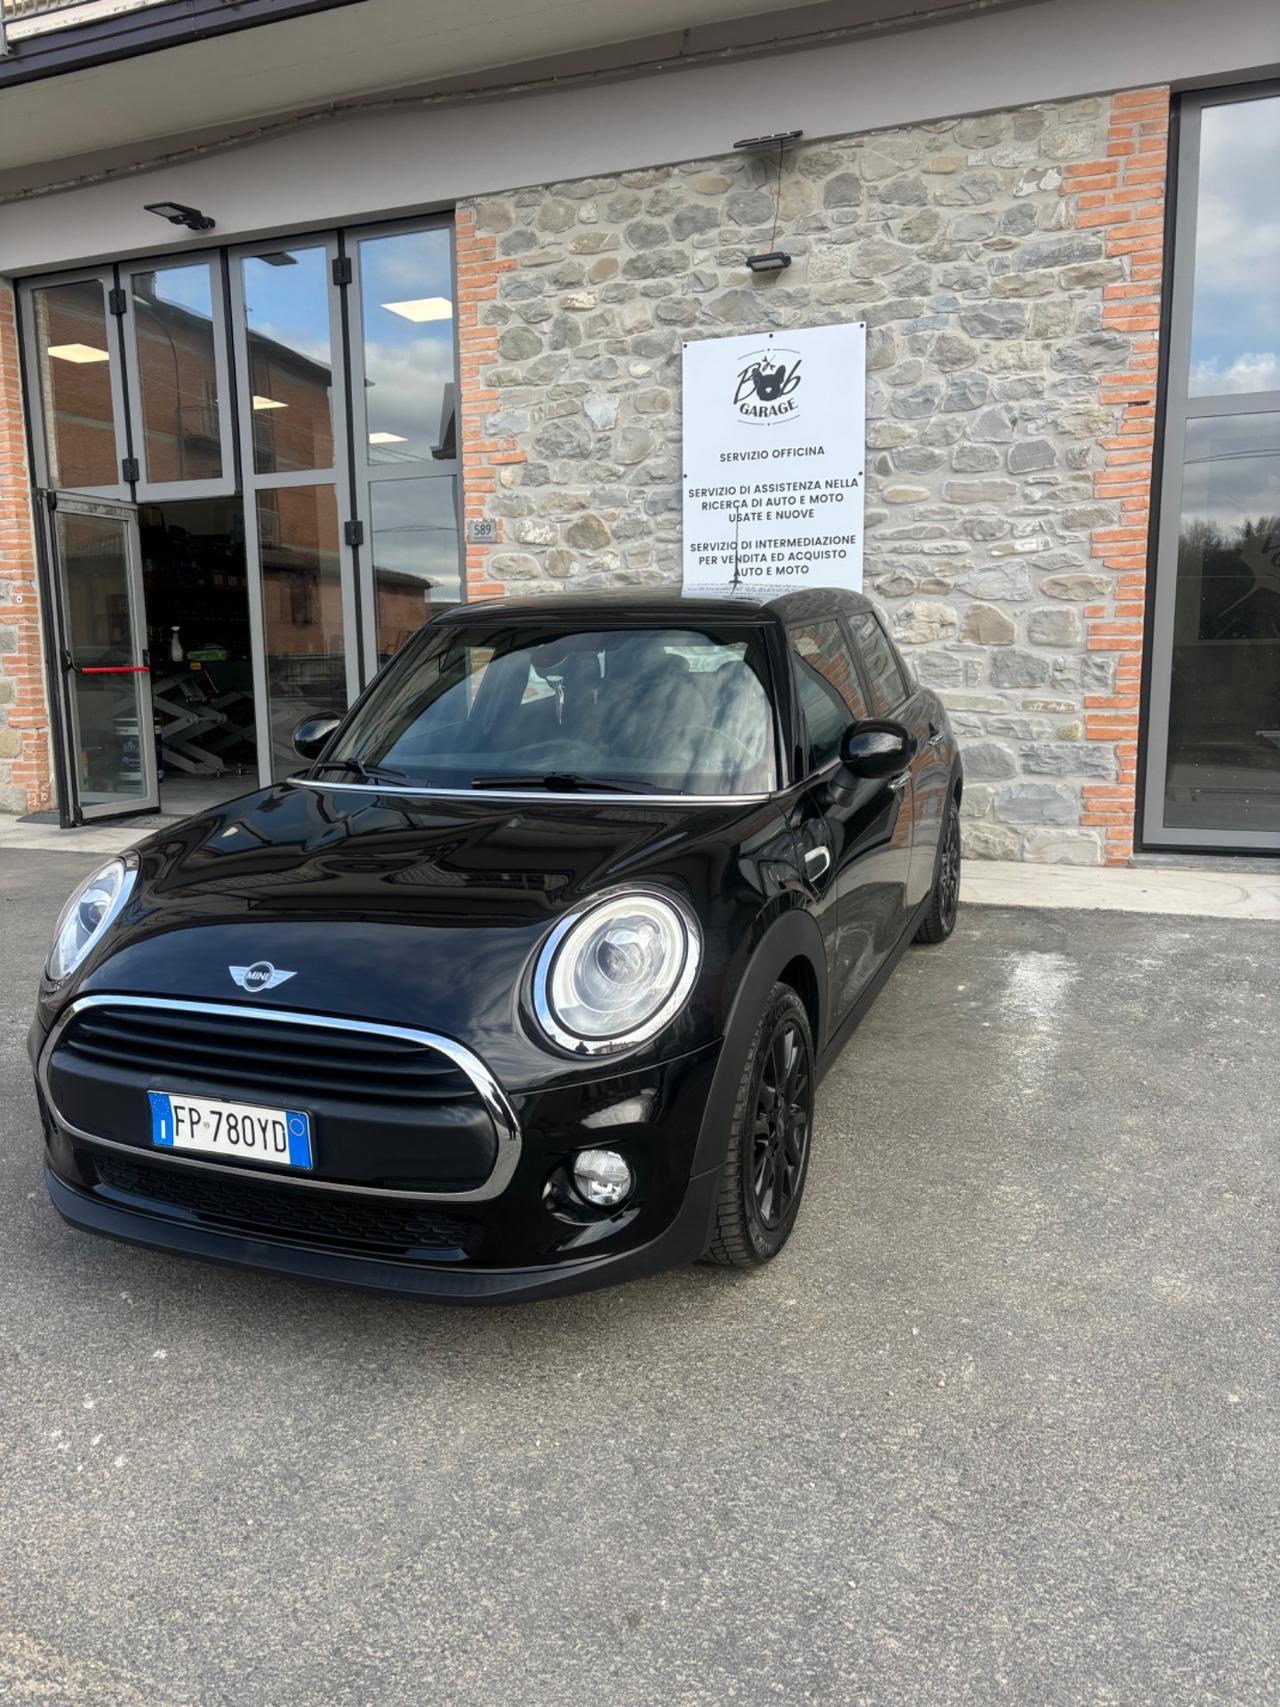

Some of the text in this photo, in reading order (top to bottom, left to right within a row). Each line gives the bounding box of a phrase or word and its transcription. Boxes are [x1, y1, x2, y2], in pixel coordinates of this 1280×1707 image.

[739, 397, 799, 418] GARAGE
[719, 446, 825, 463] SERVIZIO OFFICINA
[688, 478, 859, 498] SERVIZIO DI ASSISTENZA NELLA
[701, 493, 845, 511] RICERCA DI AUTO E MOTO
[728, 508, 815, 523] USATE E NUOVE
[474, 523, 492, 536] 589
[690, 535, 857, 552] SERVIZIO DI INTERMEDIAZIONE
[699, 549, 847, 565] PER VENDITA ED ACQUISTO
[766, 567, 772, 575] E
[775, 564, 810, 575] MOTO
[246, 970, 271, 982] MINI
